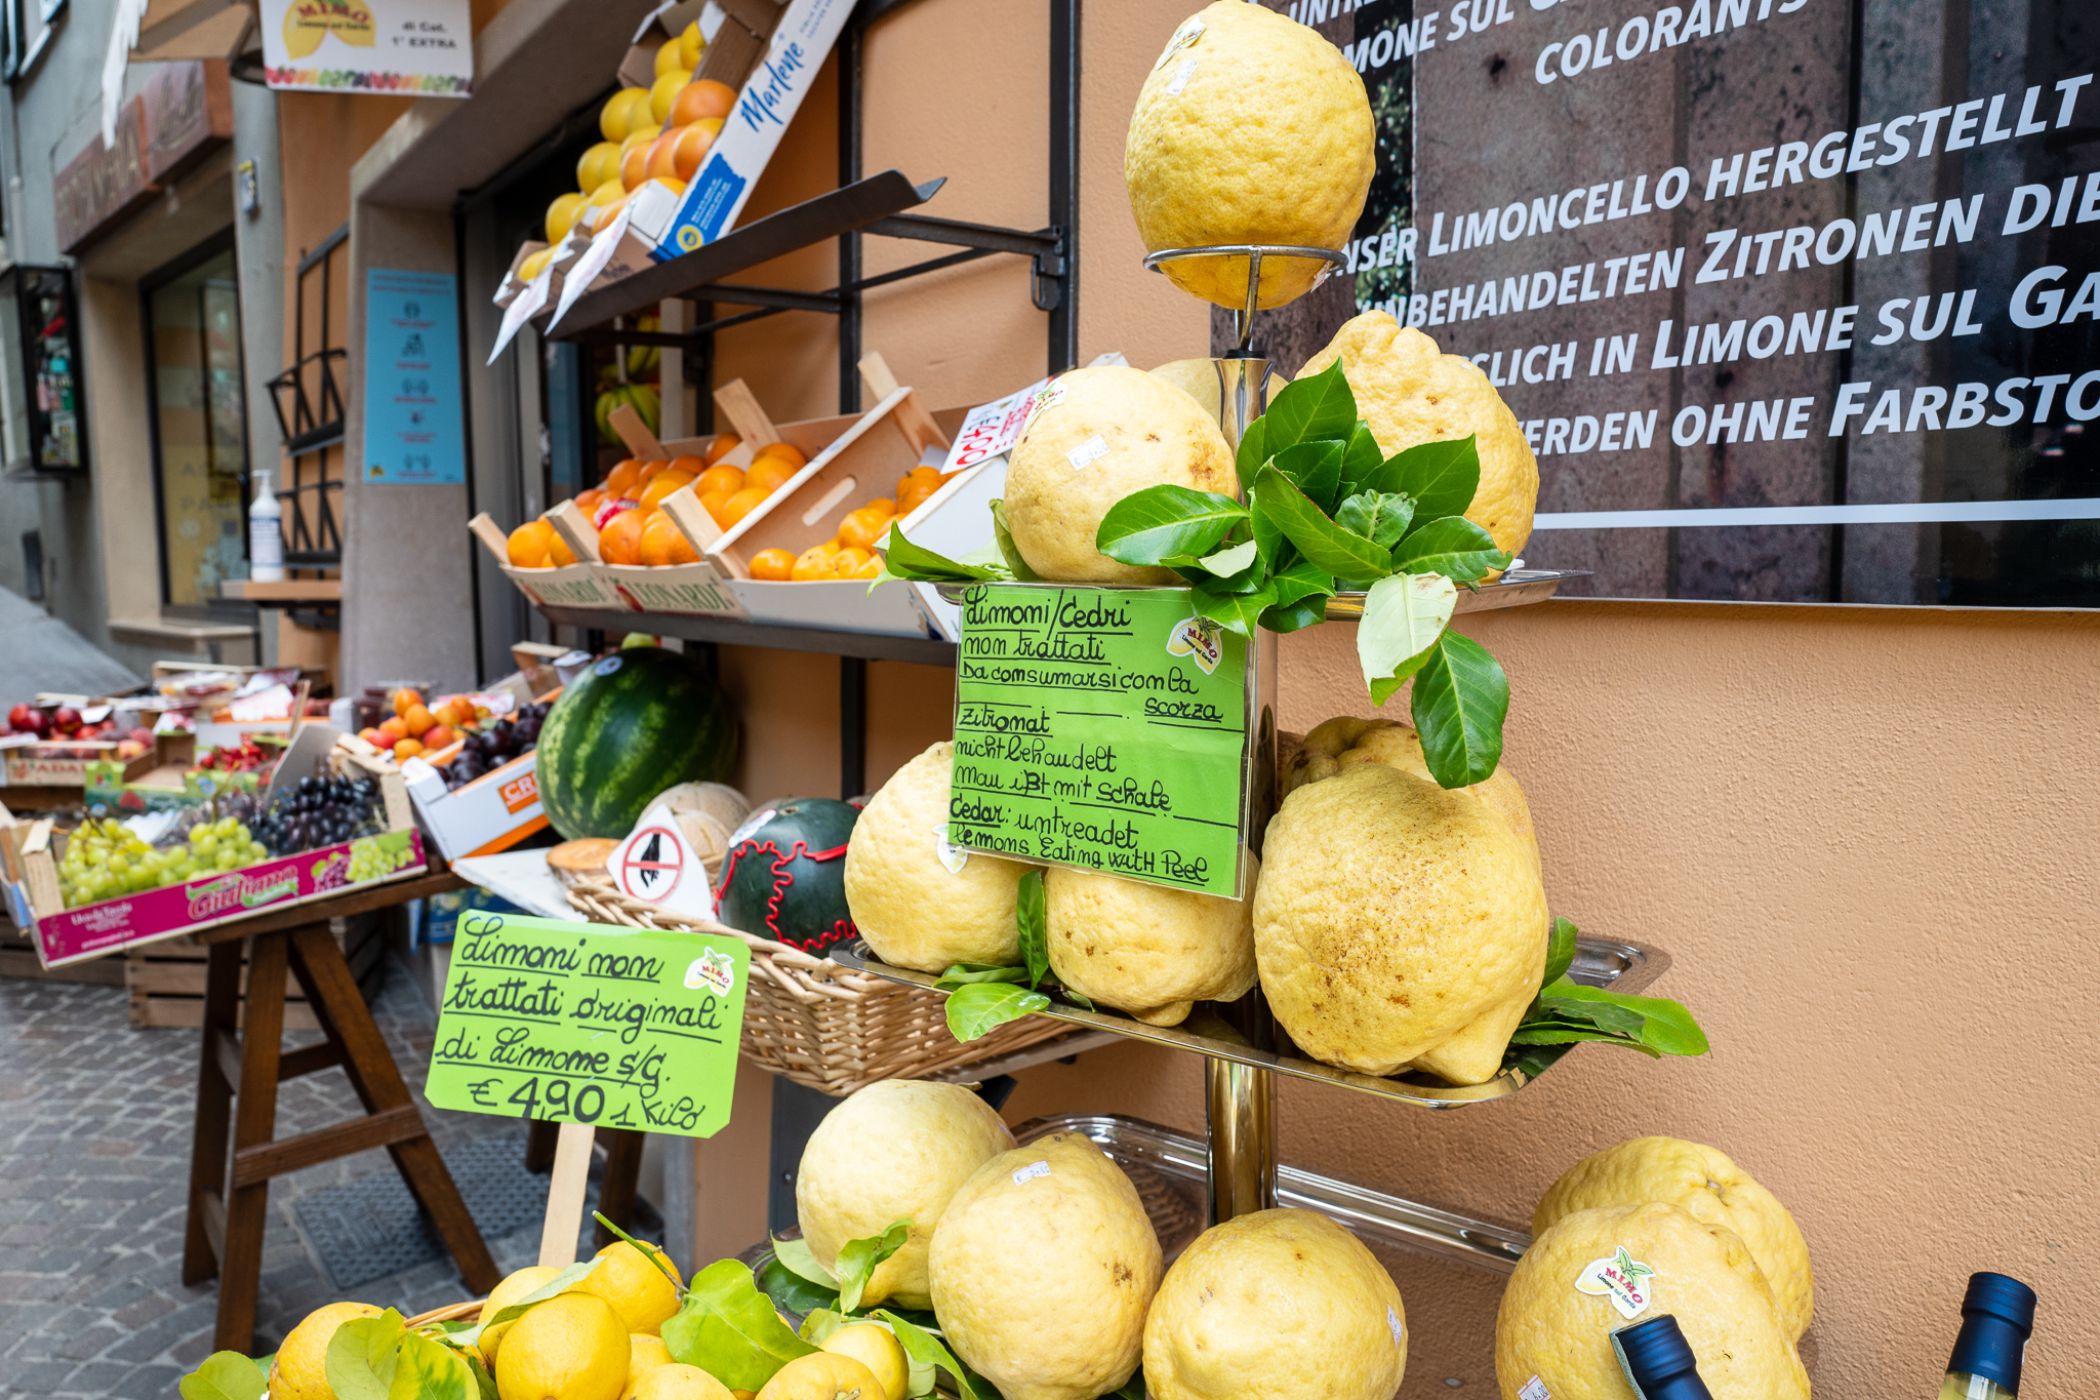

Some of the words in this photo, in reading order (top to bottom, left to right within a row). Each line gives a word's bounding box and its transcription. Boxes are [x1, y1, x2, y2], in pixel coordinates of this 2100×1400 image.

[408, 36, 458, 49] EXTRA
[1341, 11, 1440, 73] MONE
[1446, 0, 1514, 42] SUL
[1535, 0, 1808, 85] COLORAN
[739, 41, 804, 133] Marlene
[1334, 227, 1418, 277] NSER
[1427, 166, 1690, 258] LIMONCELLO
[1704, 73, 2093, 202] HERGESTELLT
[1696, 194, 1985, 285] ZITRONEN
[2001, 171, 2100, 236] DIE
[1462, 341, 1578, 389] LICH
[1589, 333, 1639, 376] IN
[1651, 304, 1859, 370] LIMONE
[1870, 288, 1983, 347] SUL
[1519, 409, 1658, 456] ERDEN
[1672, 397, 1814, 449] OHNE
[1829, 370, 2100, 437] FARBSTO
[1016, 629, 1106, 661] trattati
[1167, 666, 1200, 695] la
[955, 735, 1005, 759] nicht
[1054, 775, 1092, 798] mit
[1161, 849, 1210, 882] Peel
[461, 915, 588, 971] Limoni
[443, 970, 565, 1016] trattati
[570, 988, 729, 1044] originali
[435, 1027, 480, 1060] di
[489, 1026, 610, 1074] Limone
[467, 1078, 503, 1107] €
[1605, 1267, 1643, 1304] MIMO
